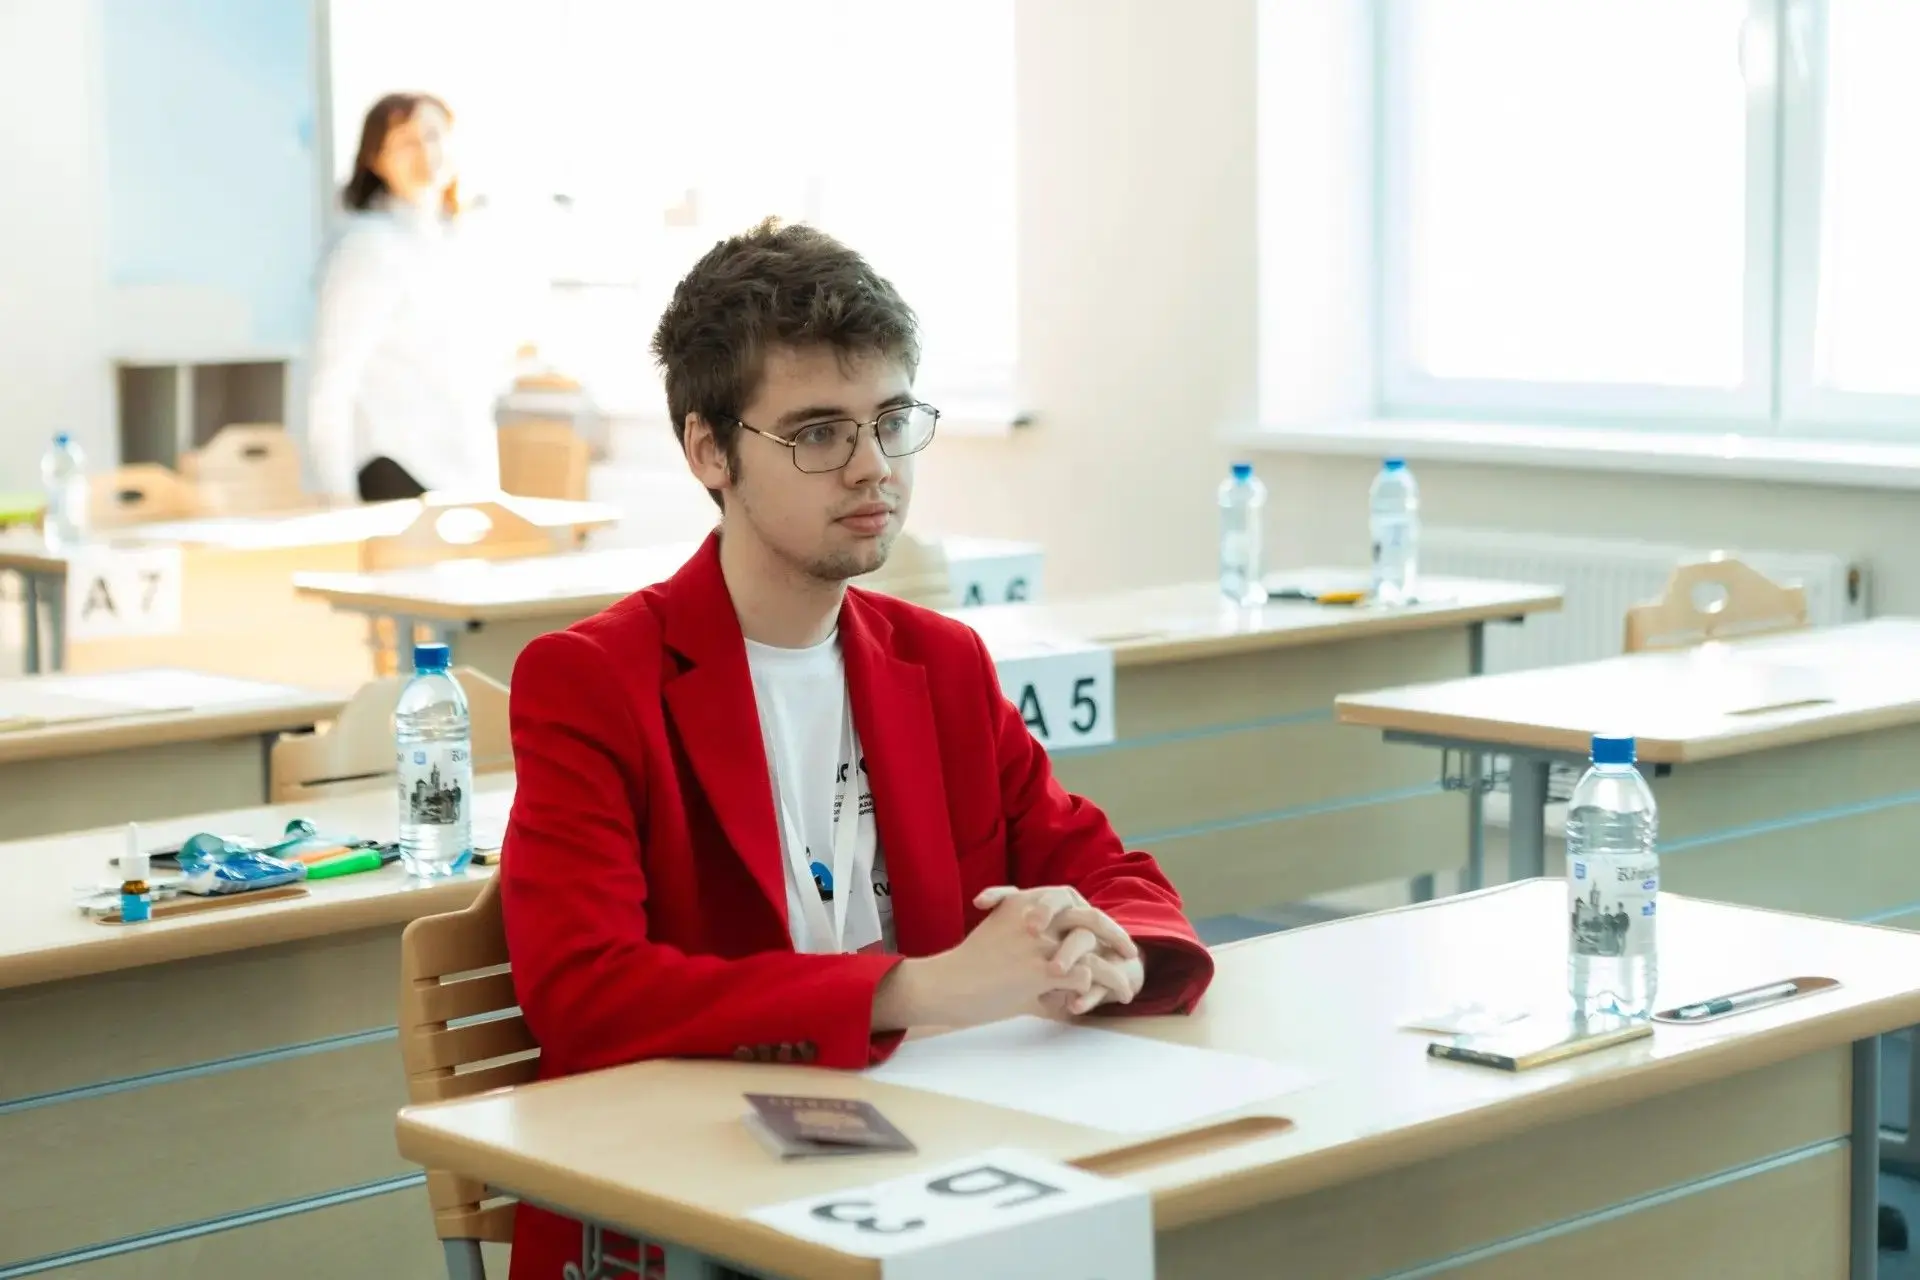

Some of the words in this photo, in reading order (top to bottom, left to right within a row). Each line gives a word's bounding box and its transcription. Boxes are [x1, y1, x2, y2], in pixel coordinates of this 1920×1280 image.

[138, 570, 160, 614] 7
[1071, 677, 1097, 735] 5
[810, 1199, 926, 1234] 3
